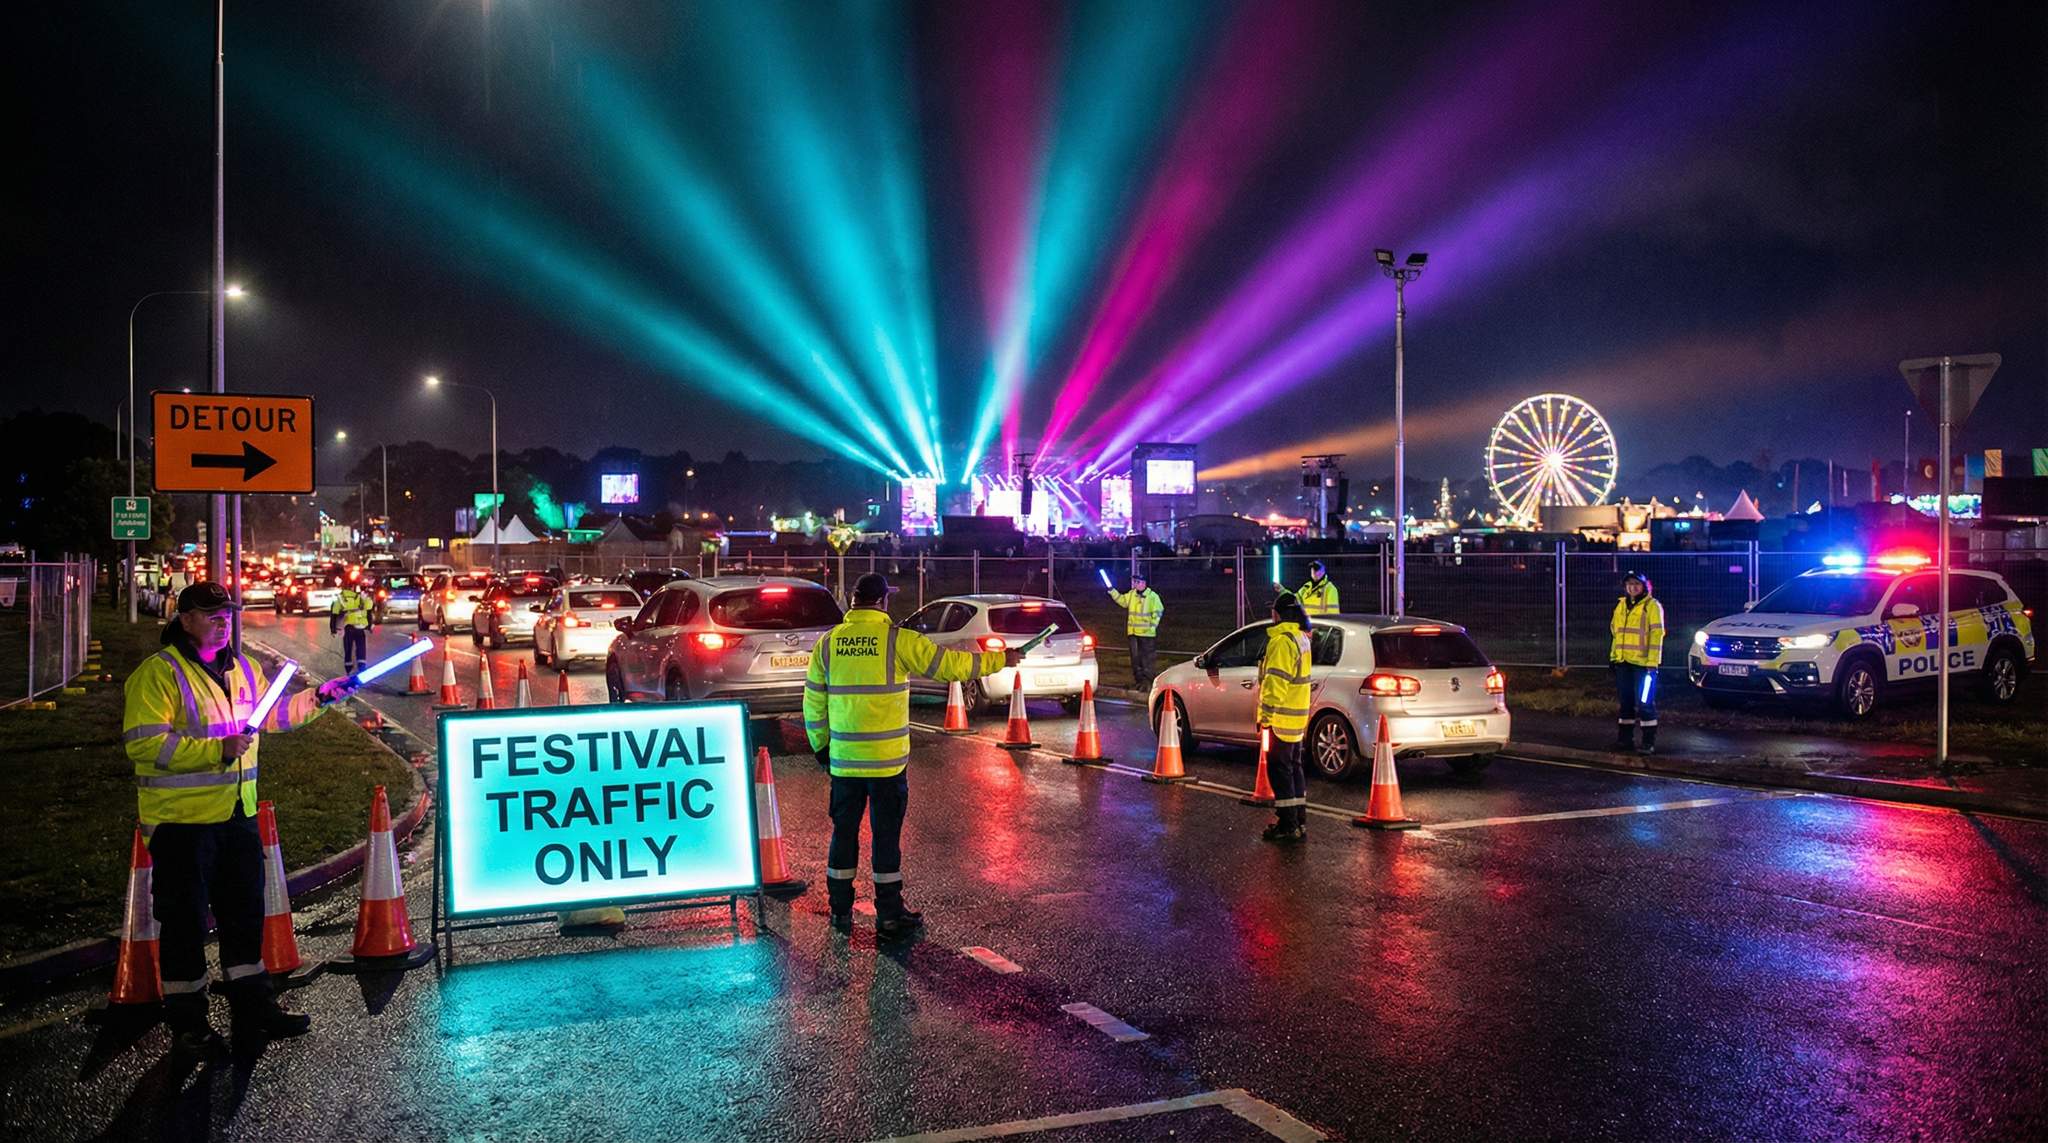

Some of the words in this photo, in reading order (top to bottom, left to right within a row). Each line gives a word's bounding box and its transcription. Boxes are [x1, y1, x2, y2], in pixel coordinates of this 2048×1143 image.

[170, 405, 296, 432] DETOUR
[836, 636, 878, 646] TRAFFIC
[836, 647, 879, 656] MARSHAL
[1899, 650, 1975, 675] POLCE
[472, 727, 725, 778] FESTIVAL
[486, 779, 714, 832] TRAFFIC
[535, 835, 678, 885] ONLY
